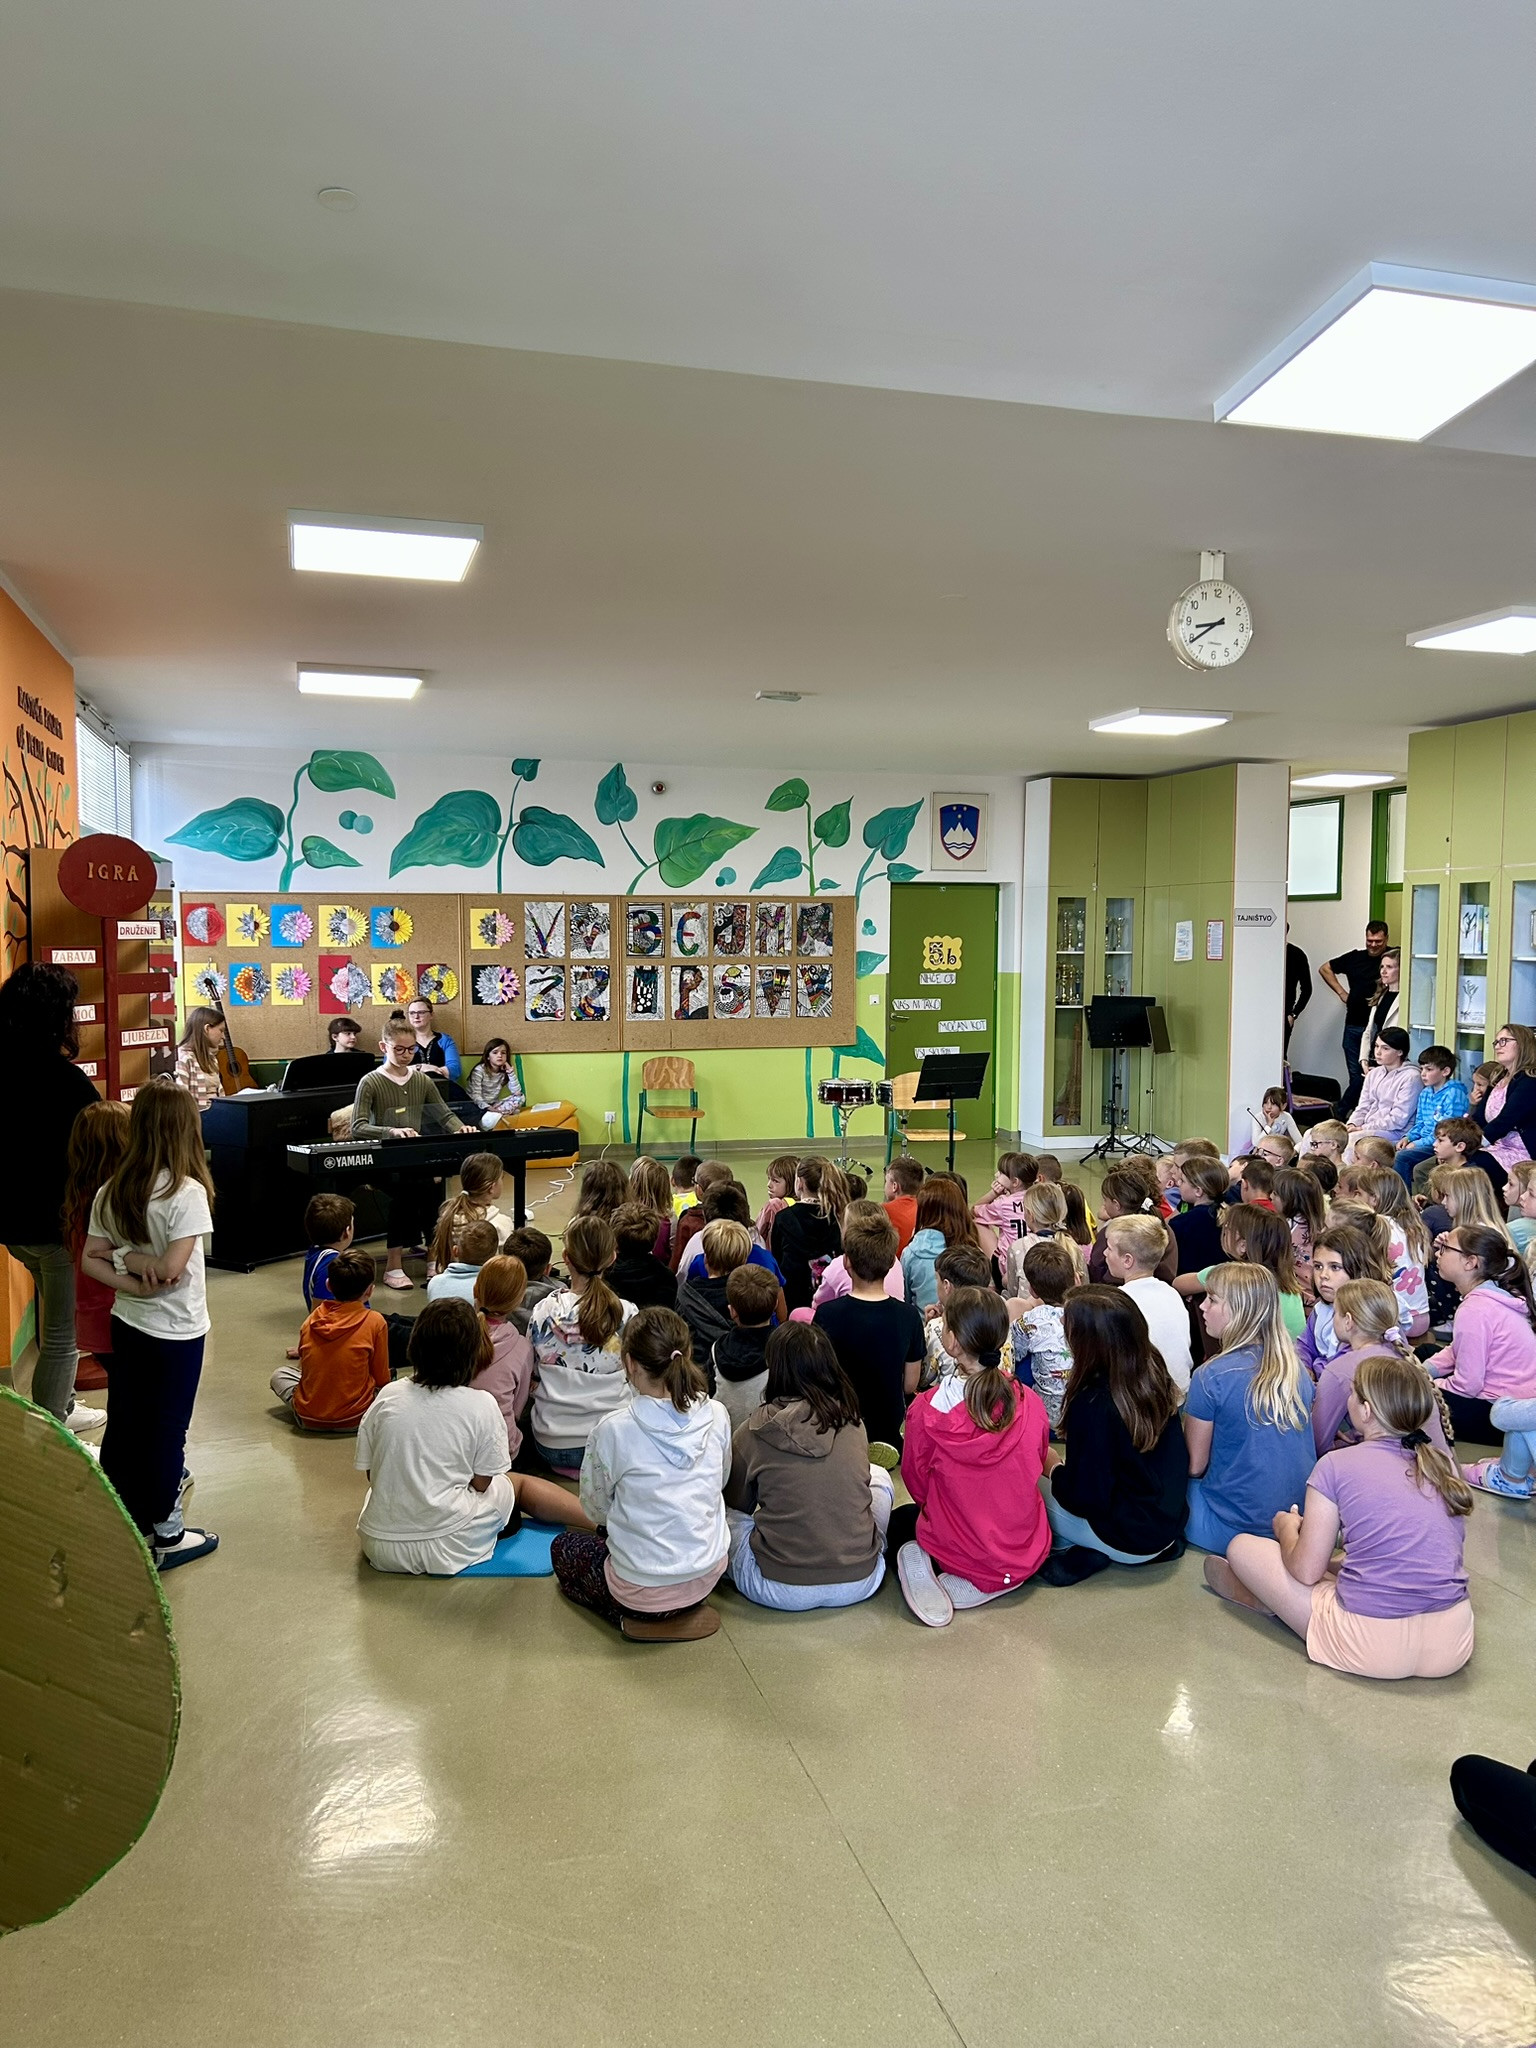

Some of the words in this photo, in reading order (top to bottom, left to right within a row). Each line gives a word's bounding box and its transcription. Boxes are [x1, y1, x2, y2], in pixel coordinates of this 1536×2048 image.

[1201, 591, 1208, 601] 11
[1214, 588, 1222, 598] 12
[1190, 600, 1199, 610] 10
[1236, 606, 1242, 616] 2
[1186, 616, 1192, 626] 9
[1239, 623, 1245, 632] 3
[1233, 638, 1239, 647] 4
[1198, 645, 1204, 654] 7
[1224, 648, 1230, 657] 5
[1211, 651, 1217, 660] 6
[87, 862, 140, 882] IGRA
[1237, 913, 1273, 922] TAJNIŠTVO
[120, 924, 158, 936] DRUŽENJE
[627, 910, 662, 954] B
[53, 950, 96, 963] ZABAVA
[929, 941, 957, 966] 5.b
[893, 999, 910, 1010] VAS
[971, 1020, 986, 1030] KOT
[122, 1028, 169, 1044] LJUBEZEN
[336, 1153, 374, 1168] YAMAHA
